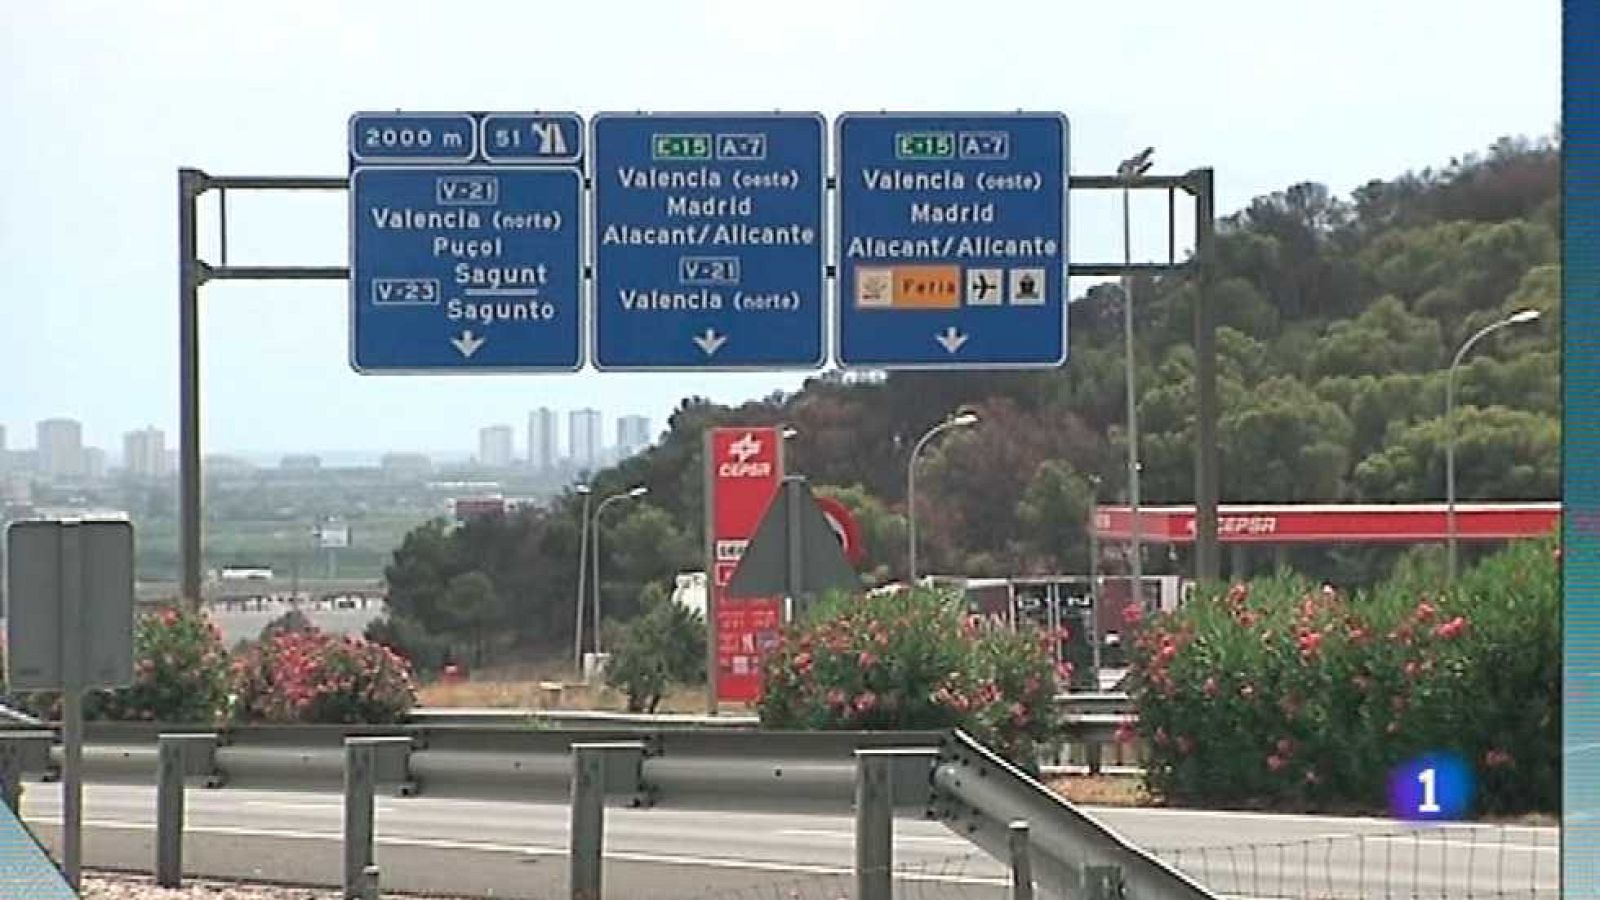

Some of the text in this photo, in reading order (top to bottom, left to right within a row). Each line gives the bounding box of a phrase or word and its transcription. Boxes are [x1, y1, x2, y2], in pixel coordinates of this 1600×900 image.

[365, 128, 462, 147] 2000 m
[495, 129, 521, 147] 51
[657, 139, 706, 155] E-15
[722, 139, 760, 155] A-7
[900, 138, 949, 155] E-15
[965, 138, 1003, 155] A-7
[618, 168, 799, 190] Valencia (oeste)
[862, 169, 1043, 192] Valencia (oeste)
[443, 181, 493, 200] V-21
[666, 196, 752, 217] Madrid
[910, 203, 995, 224] Madrid
[371, 207, 562, 231] Valencia (norte)
[602, 224, 815, 246] Alacant/Alicante
[433, 236, 502, 258] Puçol
[848, 236, 1058, 258] Alacant/Alicante
[455, 263, 547, 289] Sagunt
[685, 261, 734, 280] V-21
[378, 284, 434, 301] V-23
[619, 290, 800, 312] Valencia (norte)
[446, 299, 555, 325] Sagunto
[718, 461, 772, 478] CEPSA
